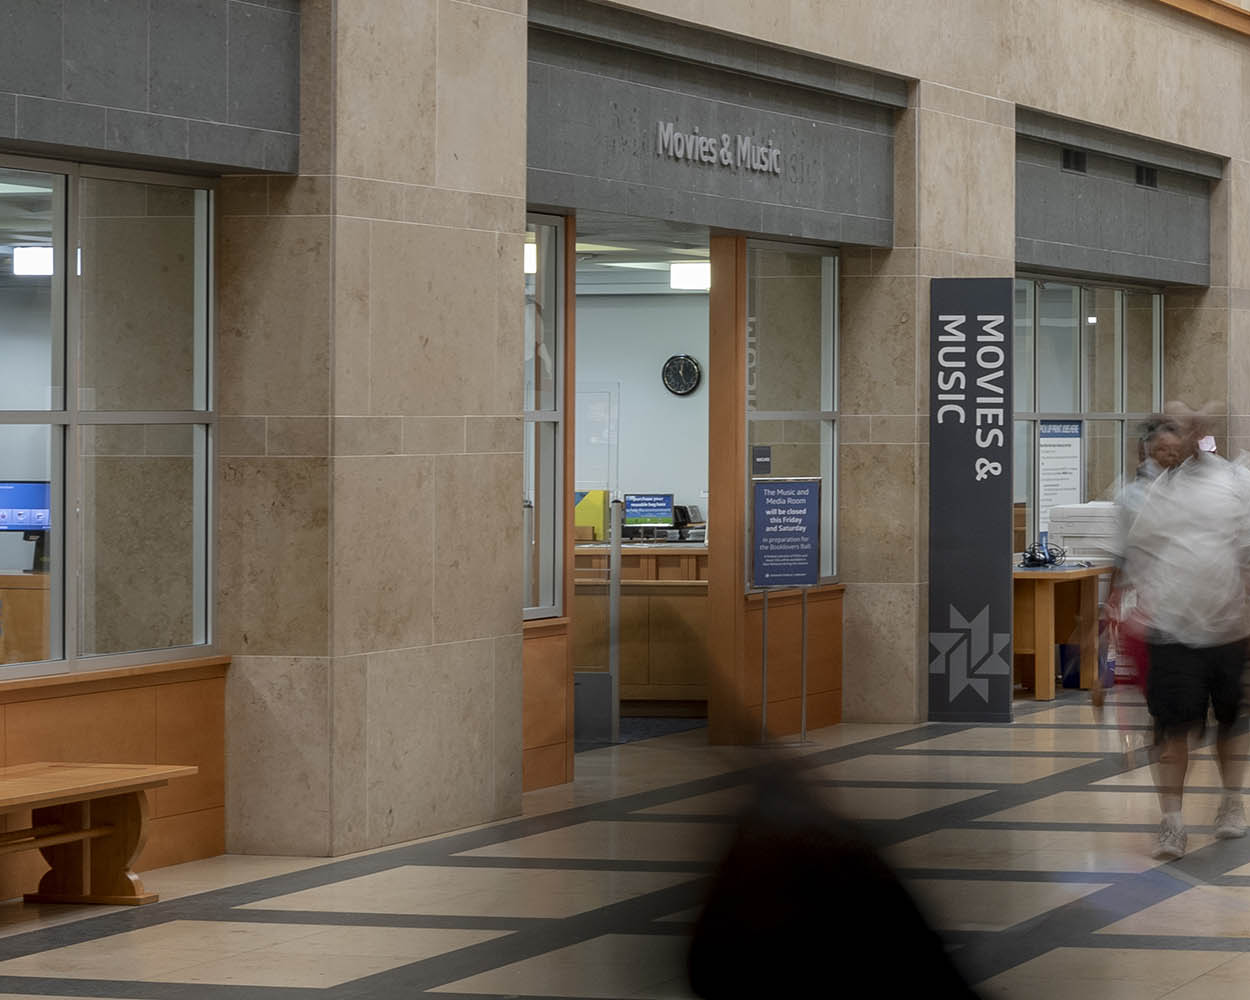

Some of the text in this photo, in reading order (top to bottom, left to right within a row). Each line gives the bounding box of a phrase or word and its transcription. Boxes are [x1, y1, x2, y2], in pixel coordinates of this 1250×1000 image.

[658, 121, 781, 174] Movies & Music
[937, 315, 966, 423] MUSIC
[974, 315, 1004, 481] MOVIES &
[787, 497, 806, 505] Room
[778, 525, 807, 533] Saturday
[782, 516, 802, 525] Friday
